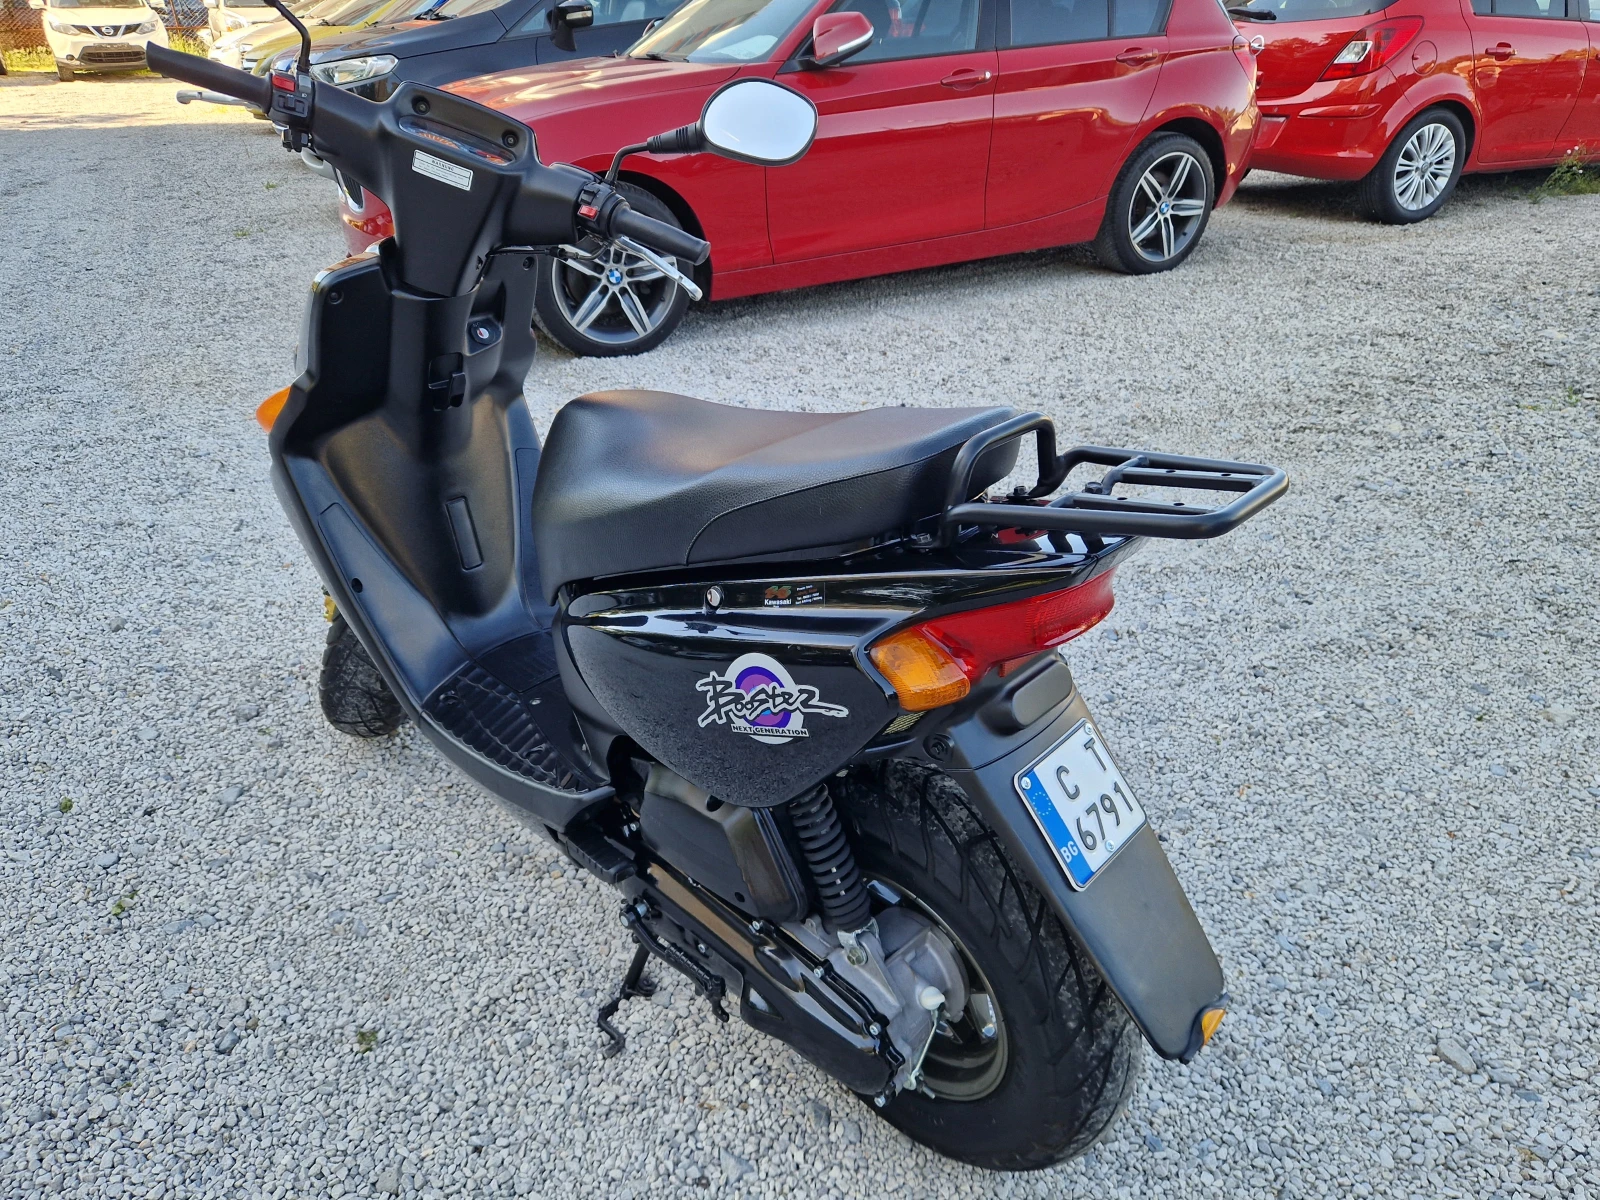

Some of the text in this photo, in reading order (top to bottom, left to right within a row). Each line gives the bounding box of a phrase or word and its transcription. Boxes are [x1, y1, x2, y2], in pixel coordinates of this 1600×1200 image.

[732, 725, 808, 736] NEXT GENERATION
[1056, 737, 1107, 800] C T
[1076, 781, 1134, 851] 6791
[1060, 840, 1079, 863] BG
